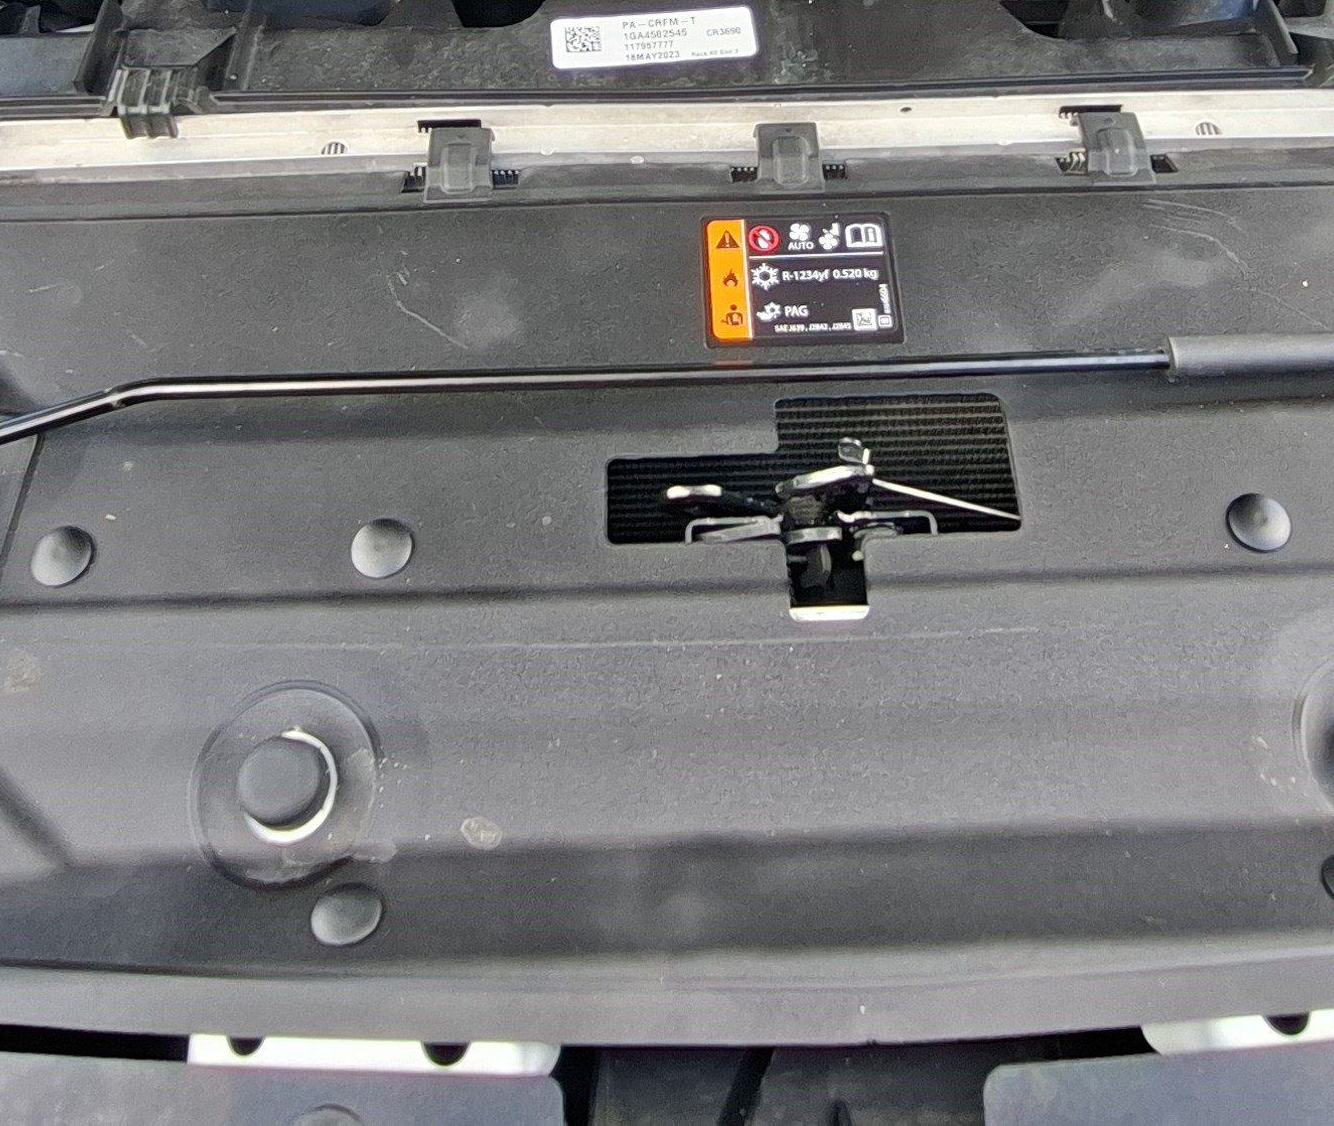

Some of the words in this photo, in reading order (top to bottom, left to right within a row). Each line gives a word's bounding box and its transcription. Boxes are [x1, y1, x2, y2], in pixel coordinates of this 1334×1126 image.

[625, 50, 680, 61] 18MAY2023
[788, 241, 815, 251] AUTO
[782, 268, 830, 282] R-1234yf
[833, 268, 861, 279] 0.520
[864, 268, 879, 281] kg
[784, 305, 809, 317] PAG
